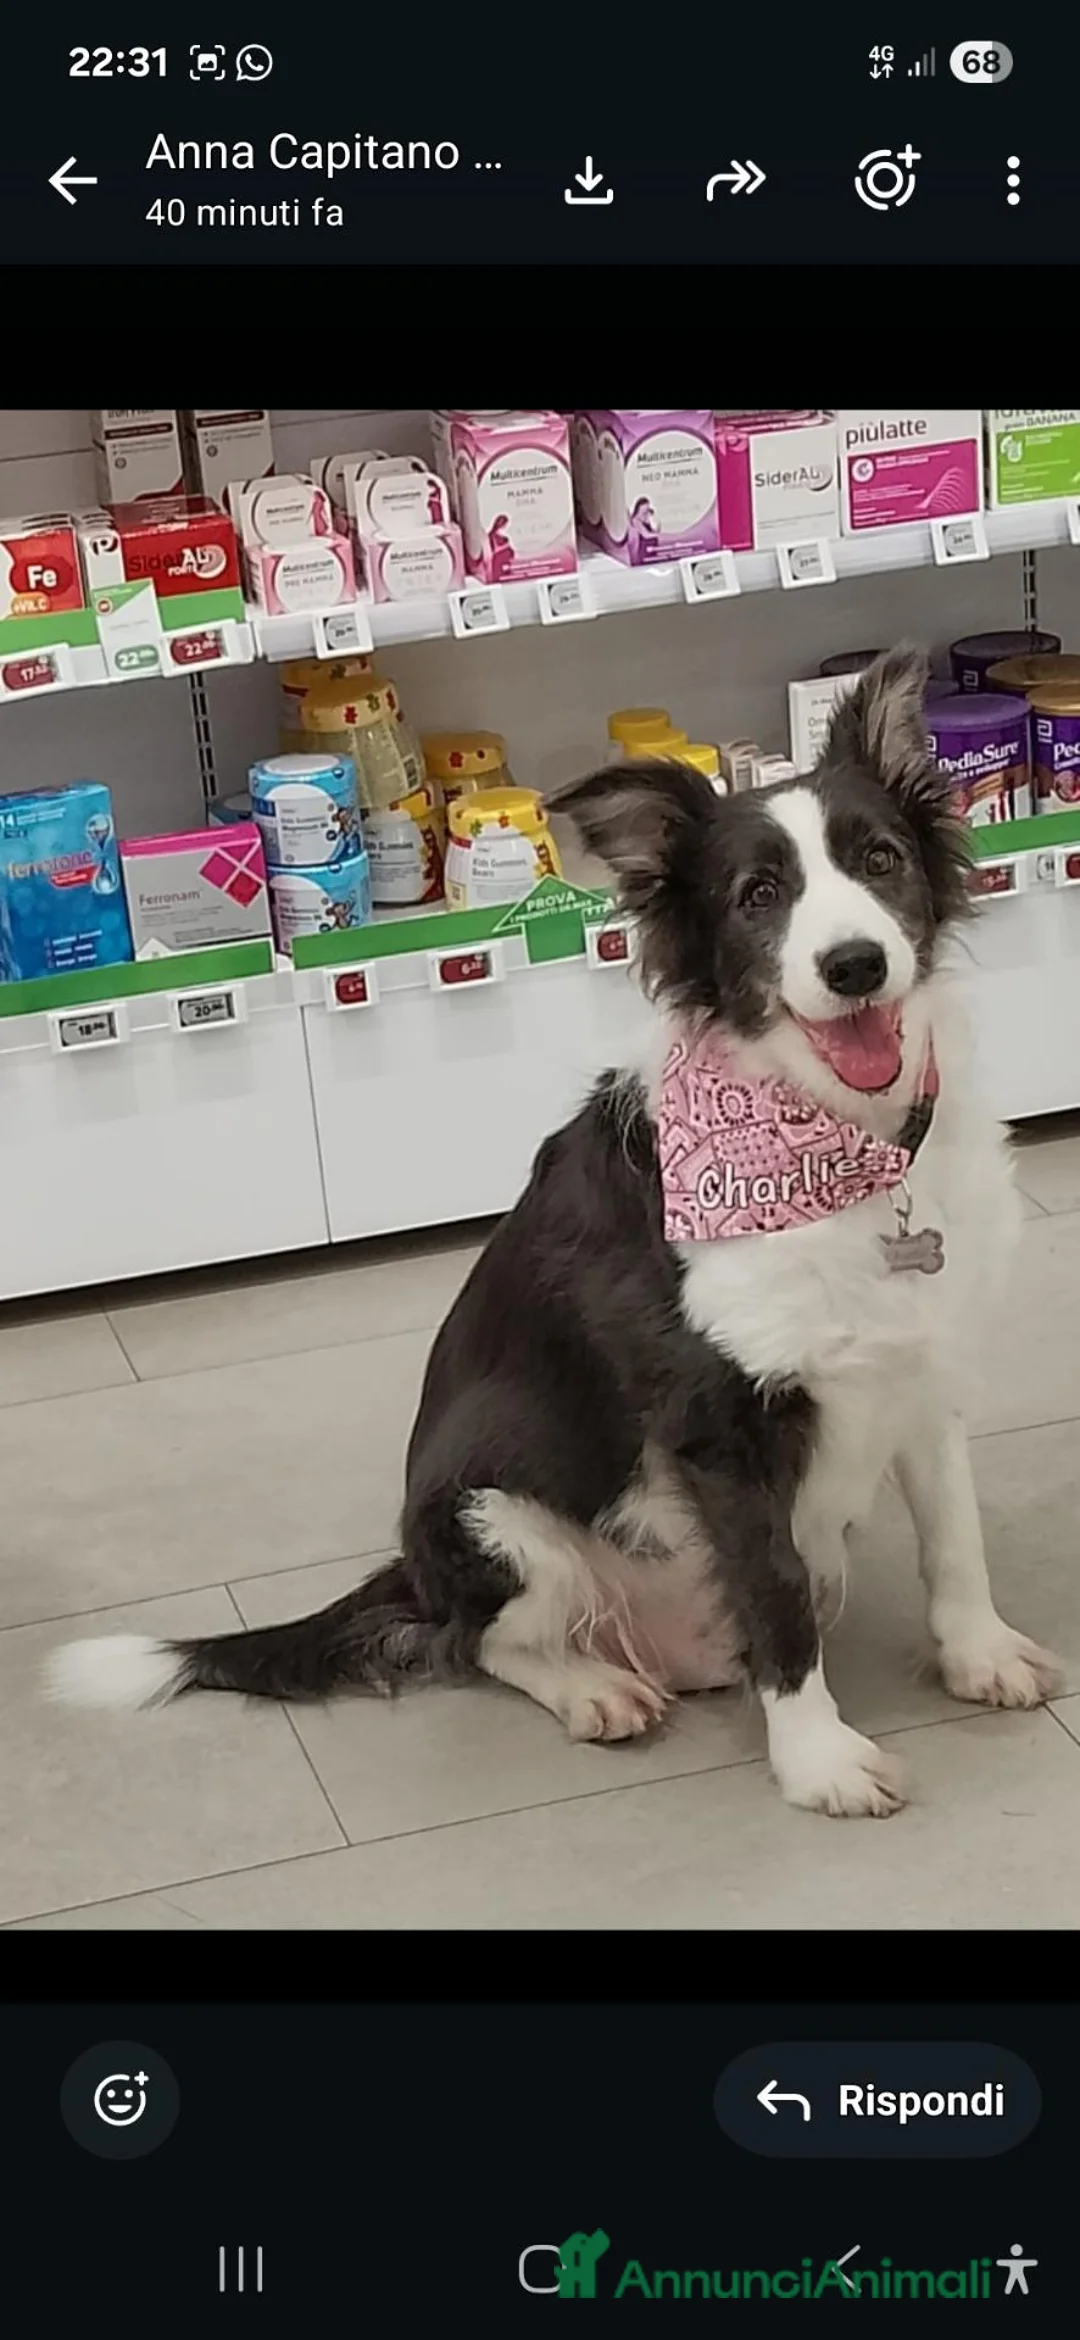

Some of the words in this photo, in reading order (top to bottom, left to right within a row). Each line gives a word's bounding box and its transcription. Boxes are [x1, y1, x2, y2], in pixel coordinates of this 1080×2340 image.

[70, 47, 166, 77] 22:31
[869, 46, 894, 61] 4G
[962, 49, 1002, 75] 68
[146, 134, 254, 169] Anna
[271, 133, 458, 178] Capitano
[146, 199, 184, 226] 40
[198, 199, 299, 226] minuti
[312, 197, 343, 226] fa
[846, 419, 927, 449] piùlatte
[636, 446, 704, 463] Multicentrum
[490, 463, 559, 482] Multicentrum
[642, 471, 661, 482] NEO
[664, 467, 699, 479] MAMMA
[507, 487, 544, 499] MAMMA
[27, 564, 58, 590] Fe
[139, 890, 201, 906] Ferronam
[526, 890, 577, 912] PROVA
[696, 1151, 863, 1212] Charlie
[840, 2083, 1003, 2124] Rispondi
